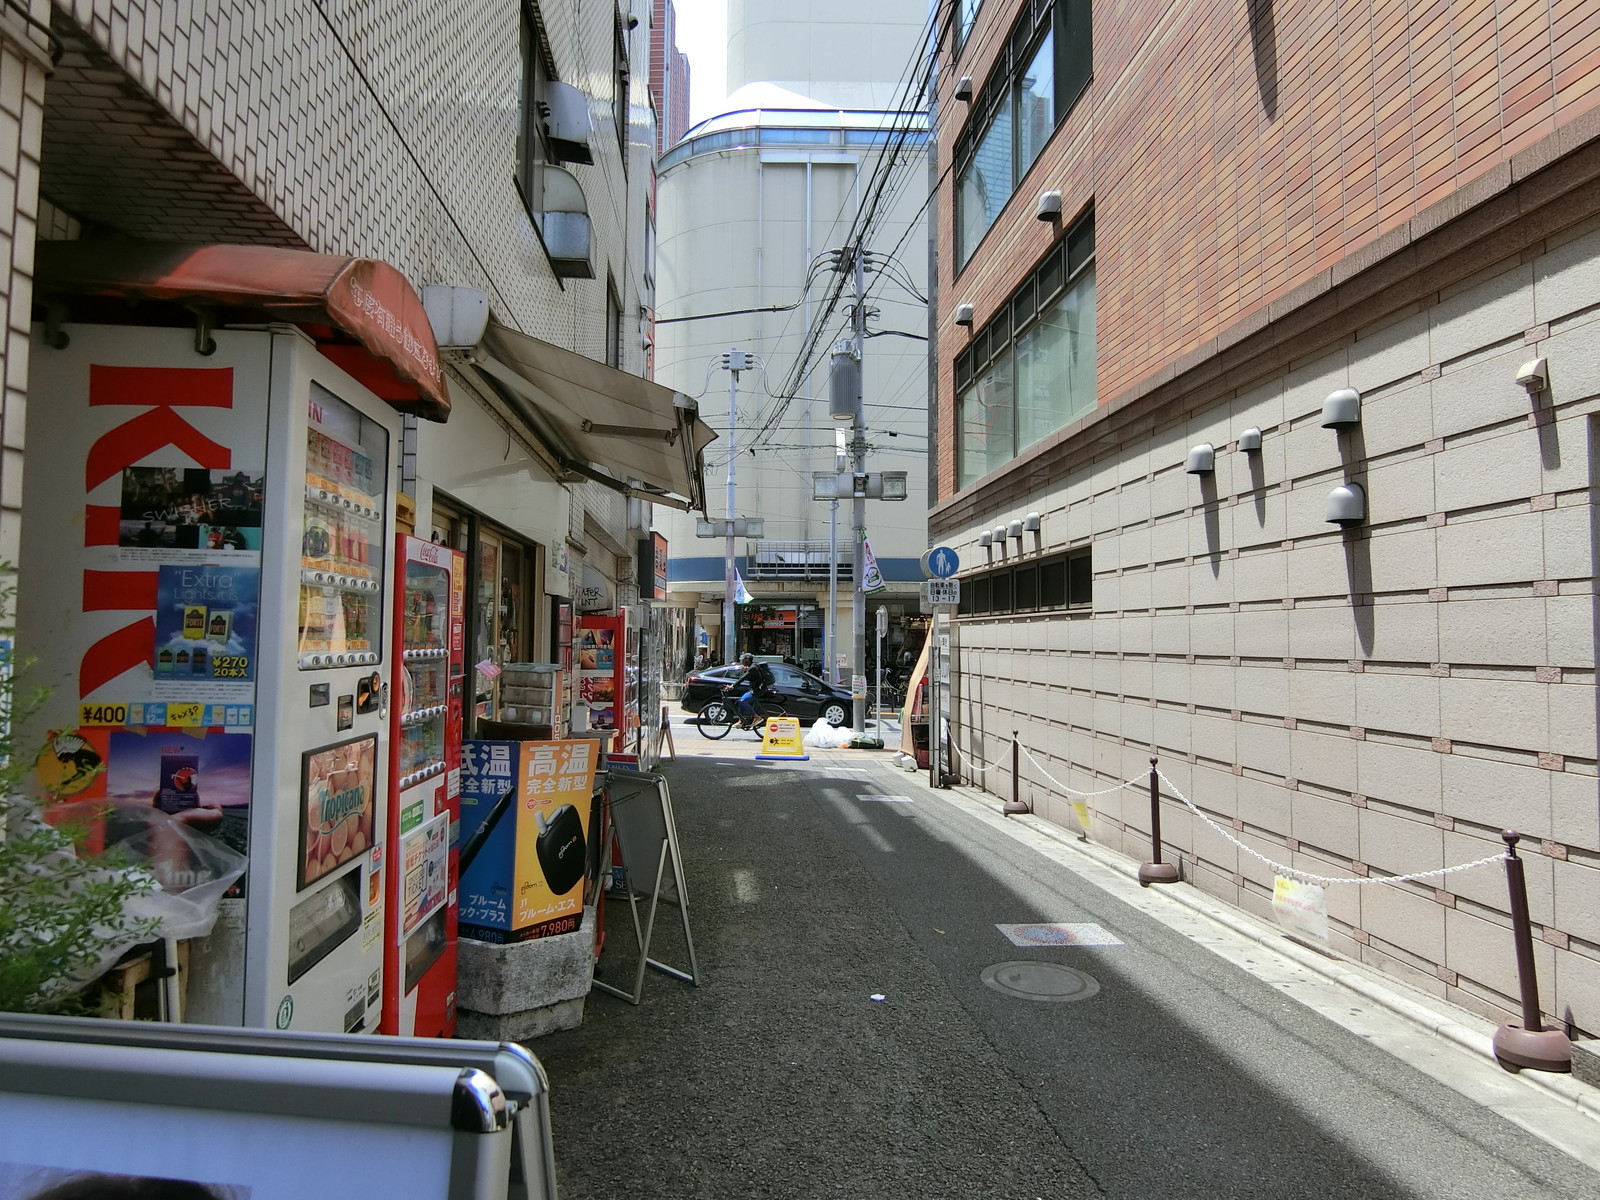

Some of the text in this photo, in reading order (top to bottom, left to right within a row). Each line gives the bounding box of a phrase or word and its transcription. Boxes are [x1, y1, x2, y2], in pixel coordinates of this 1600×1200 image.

[142, 496, 236, 523] SWISHER
[187, 618, 204, 628] FORTE
[212, 656, 248, 668] ¥270
[213, 668, 248, 677] 20本入
[83, 706, 126, 723] ¥400
[528, 744, 590, 777] 高温
[460, 777, 512, 796] 全新型
[526, 776, 587, 796] 完全新型
[319, 785, 365, 822] Tropicana
[541, 918, 575, 937] 7,980円
